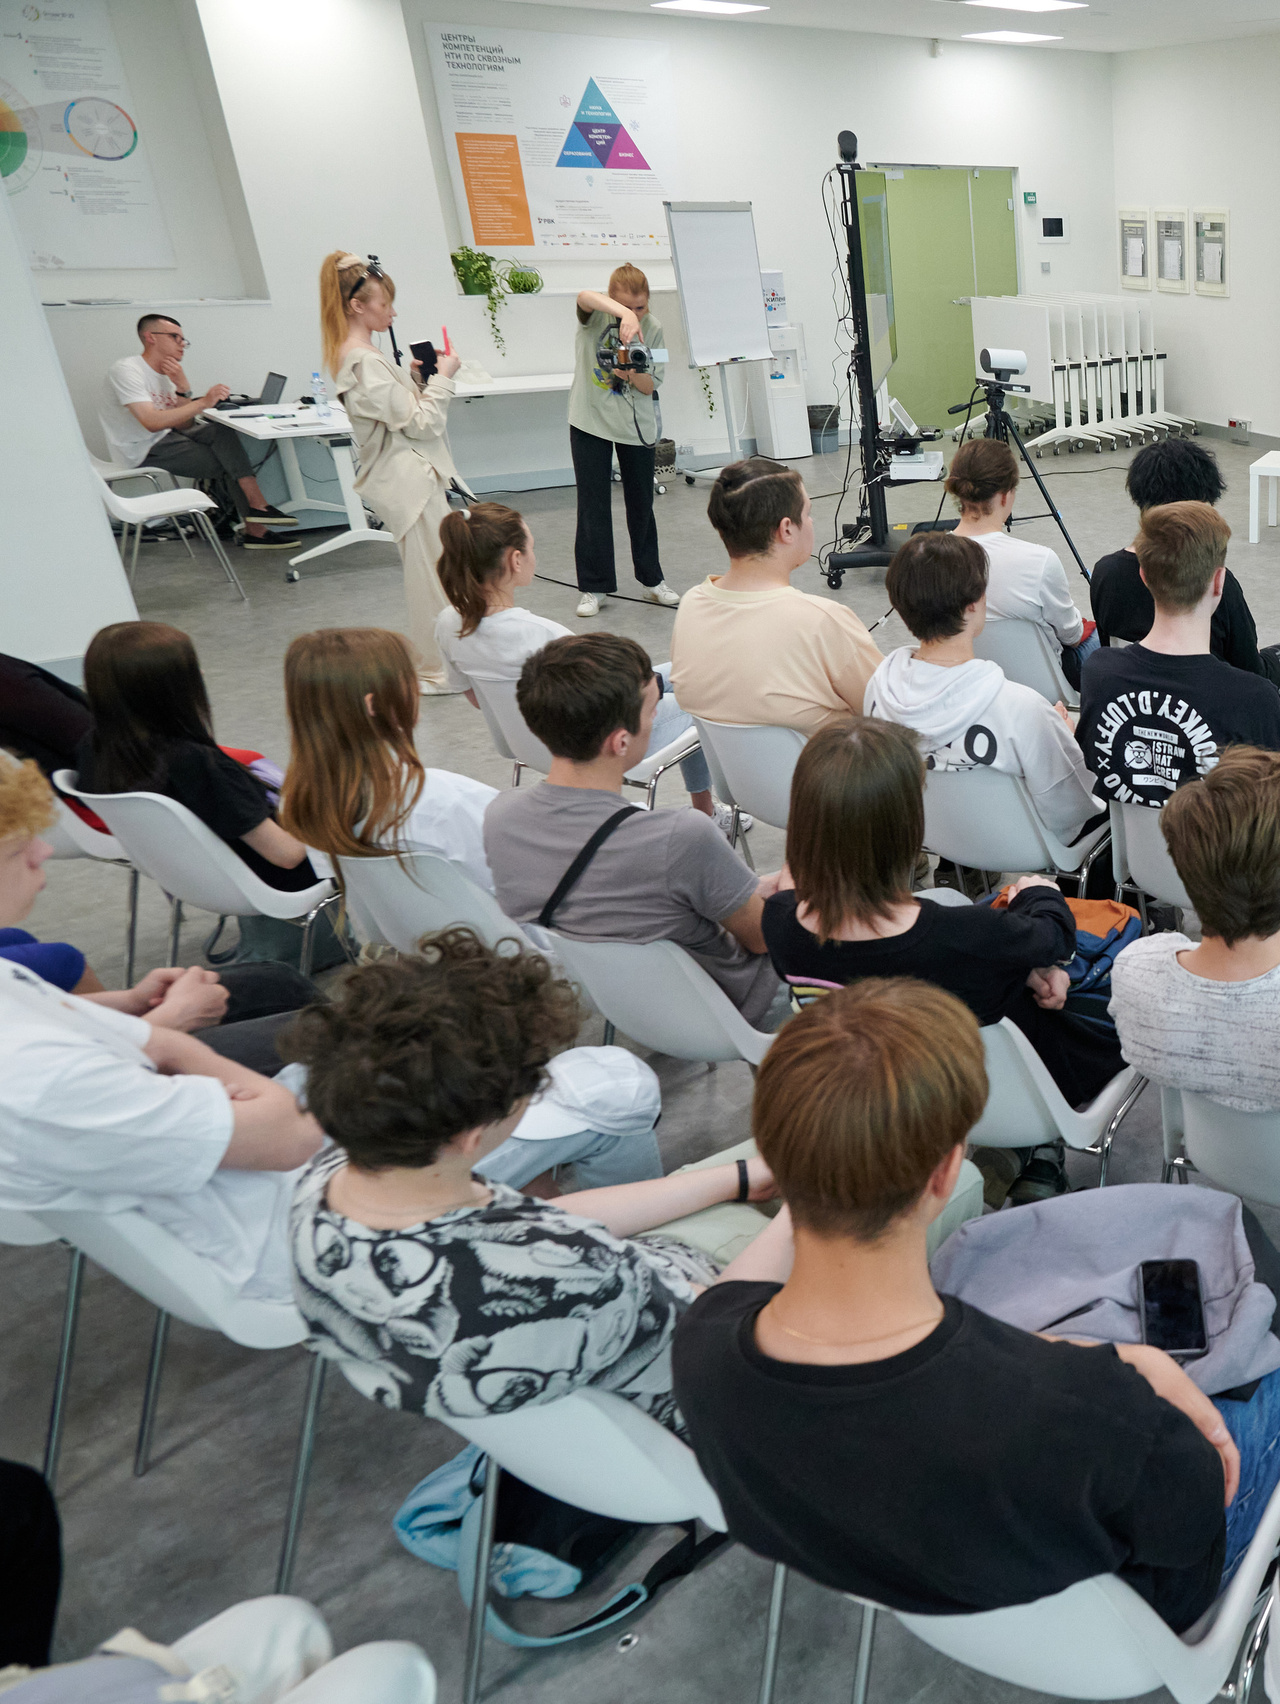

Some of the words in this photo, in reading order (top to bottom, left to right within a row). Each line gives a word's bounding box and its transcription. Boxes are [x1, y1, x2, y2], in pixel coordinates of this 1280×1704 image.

[440, 33, 476, 43] ЦЕНТРЫ
[442, 42, 504, 54] КОМПЕТЕНЦИЙ
[445, 52, 461, 60] НТИ
[464, 53, 475, 61] ПО
[478, 54, 521, 64] СКВОЗНЫМ
[446, 61, 505, 72] ТЕХНОЛОГИЯМ
[1159, 732, 1174, 741] WORLD
[1155, 742, 1186, 758] STRAW
[1155, 753, 1173, 767] HAT
[1156, 765, 1181, 781] CREW
